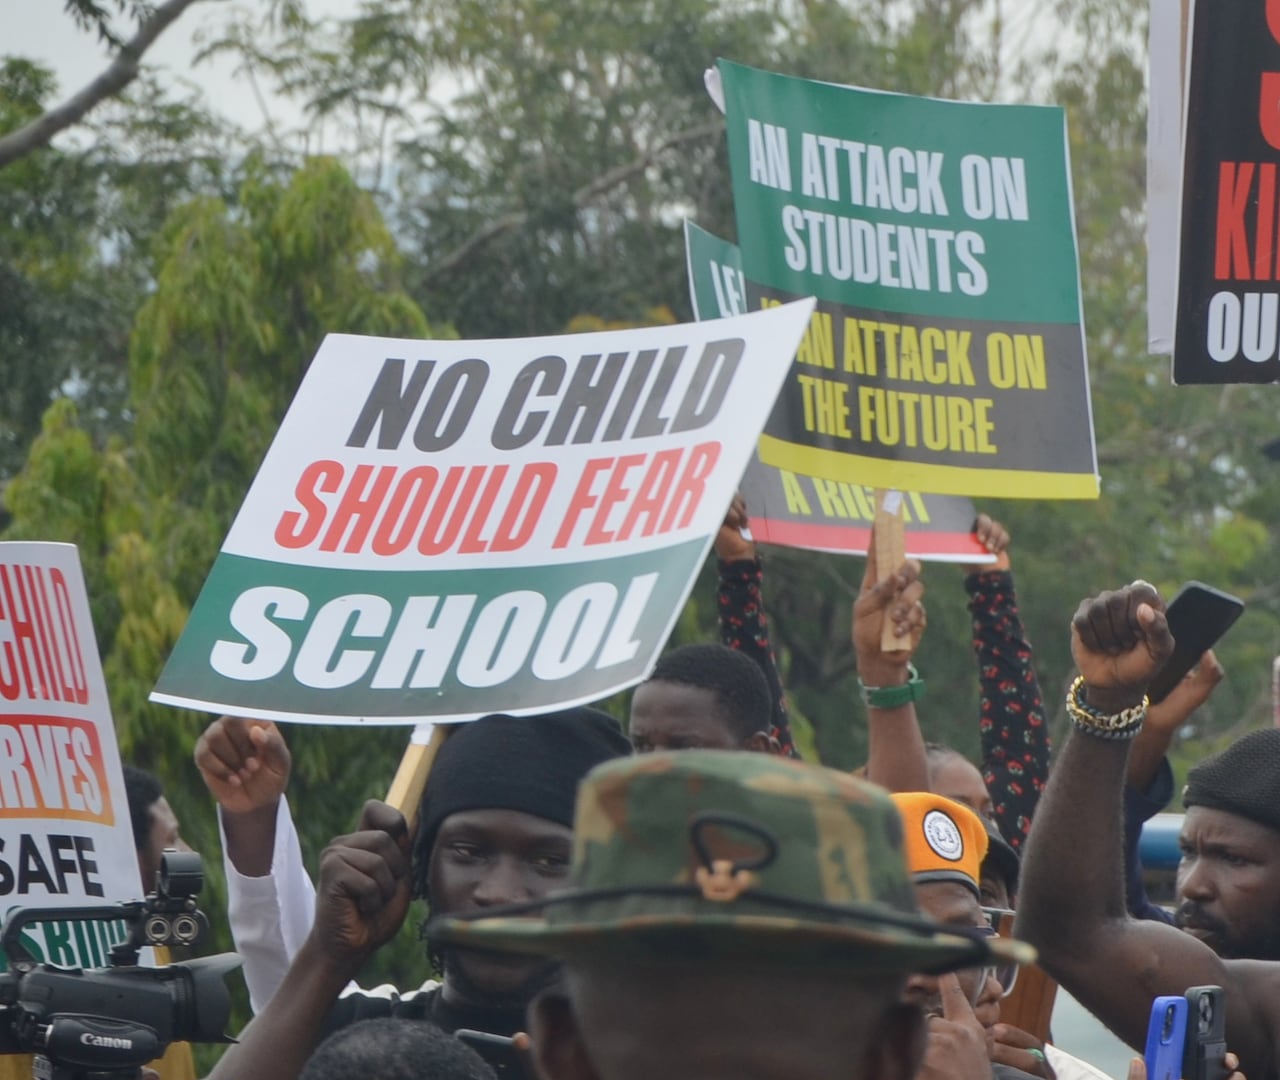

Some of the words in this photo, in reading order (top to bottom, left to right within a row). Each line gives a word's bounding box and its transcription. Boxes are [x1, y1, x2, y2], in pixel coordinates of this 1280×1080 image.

[748, 119, 791, 191] AN
[802, 133, 949, 216] ATTACK
[960, 154, 1029, 221] ON
[782, 205, 988, 296] STUDENTS
[346, 356, 491, 453] NO
[491, 337, 746, 451] CHILD
[844, 318, 975, 386] ATTACK
[986, 333, 1047, 390] ON
[798, 375, 850, 439] THE
[858, 386, 997, 454] FUTURE
[274, 459, 558, 557] SHOULD
[552, 440, 722, 550] FEAR
[780, 469, 812, 515] A
[209, 572, 660, 690] SCHOOL
[80, 1033, 132, 1050] Canon
